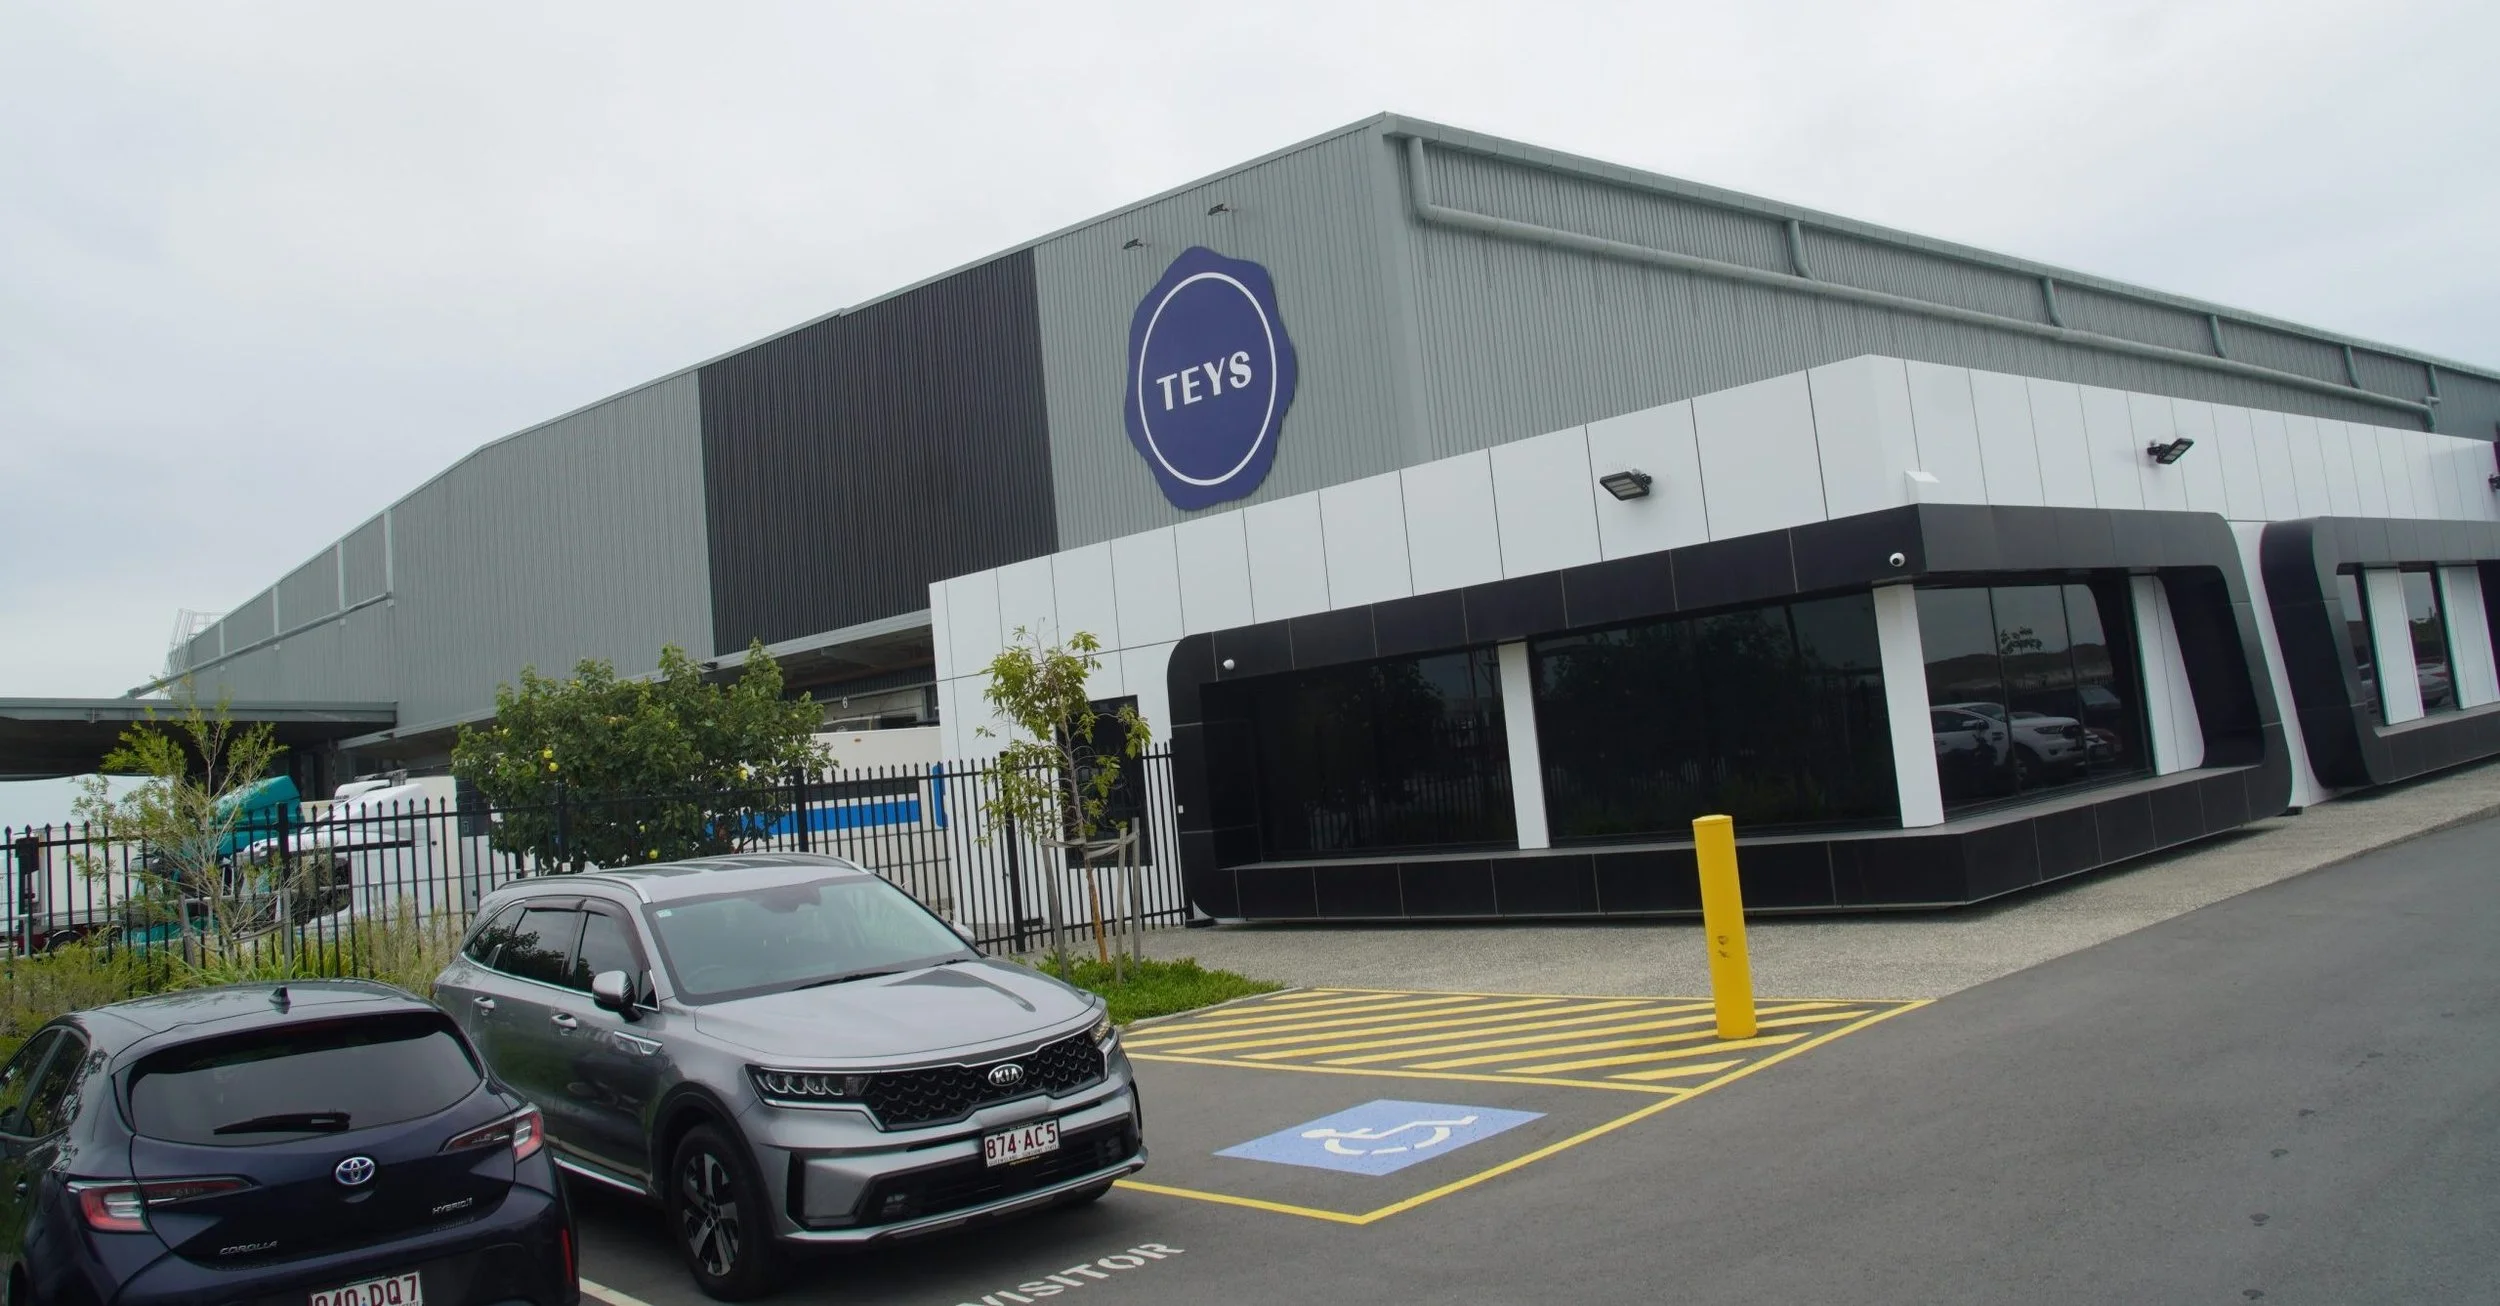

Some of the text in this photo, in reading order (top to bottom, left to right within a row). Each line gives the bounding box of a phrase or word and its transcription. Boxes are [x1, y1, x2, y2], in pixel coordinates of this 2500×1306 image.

[1156, 351, 1252, 411] TEYS
[994, 1067, 1020, 1084] KIA
[219, 1240, 278, 1255] COROLLA
